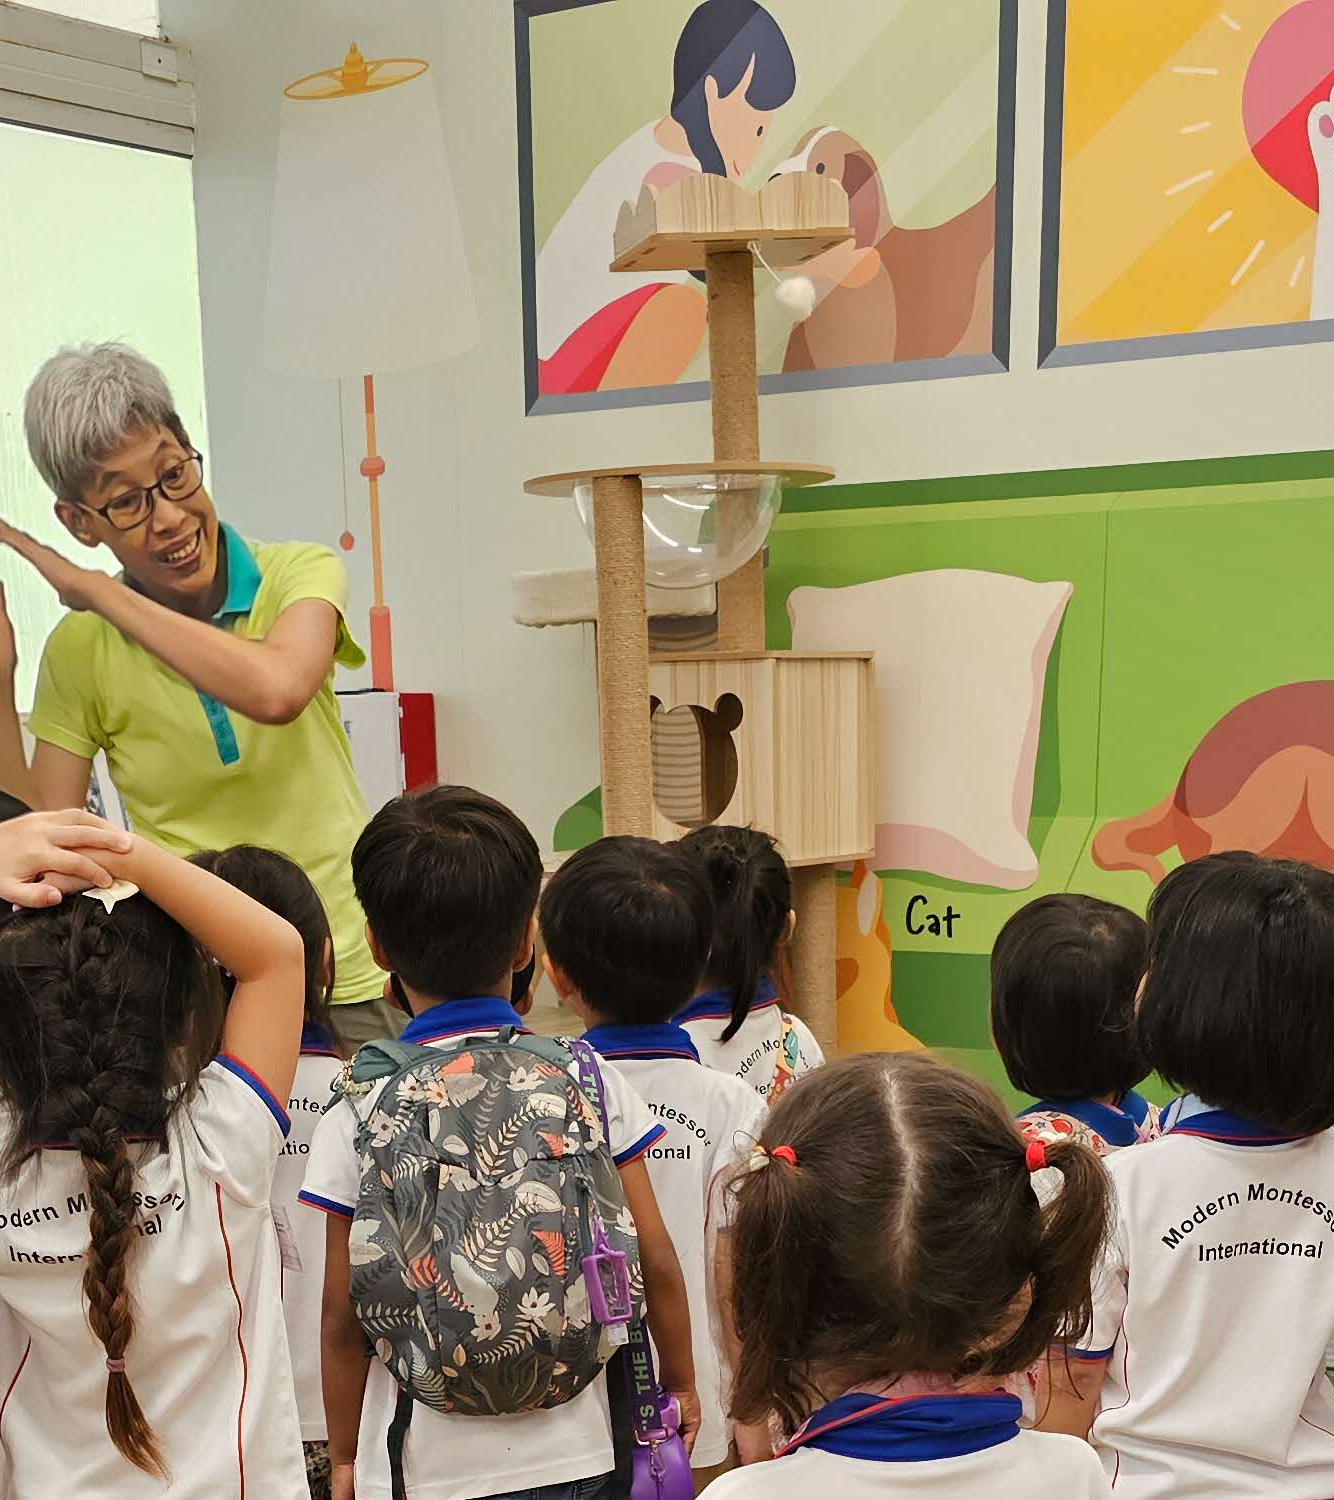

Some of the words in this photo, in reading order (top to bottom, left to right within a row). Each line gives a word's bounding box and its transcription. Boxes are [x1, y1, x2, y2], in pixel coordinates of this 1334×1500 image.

[906, 895, 961, 938] Cat
[735, 1048, 762, 1079] dern
[648, 1103, 711, 1147] ntesso
[1161, 1190, 1240, 1250] Modern
[1198, 1237, 1324, 1262] International
[631, 1351, 652, 1396] THE
